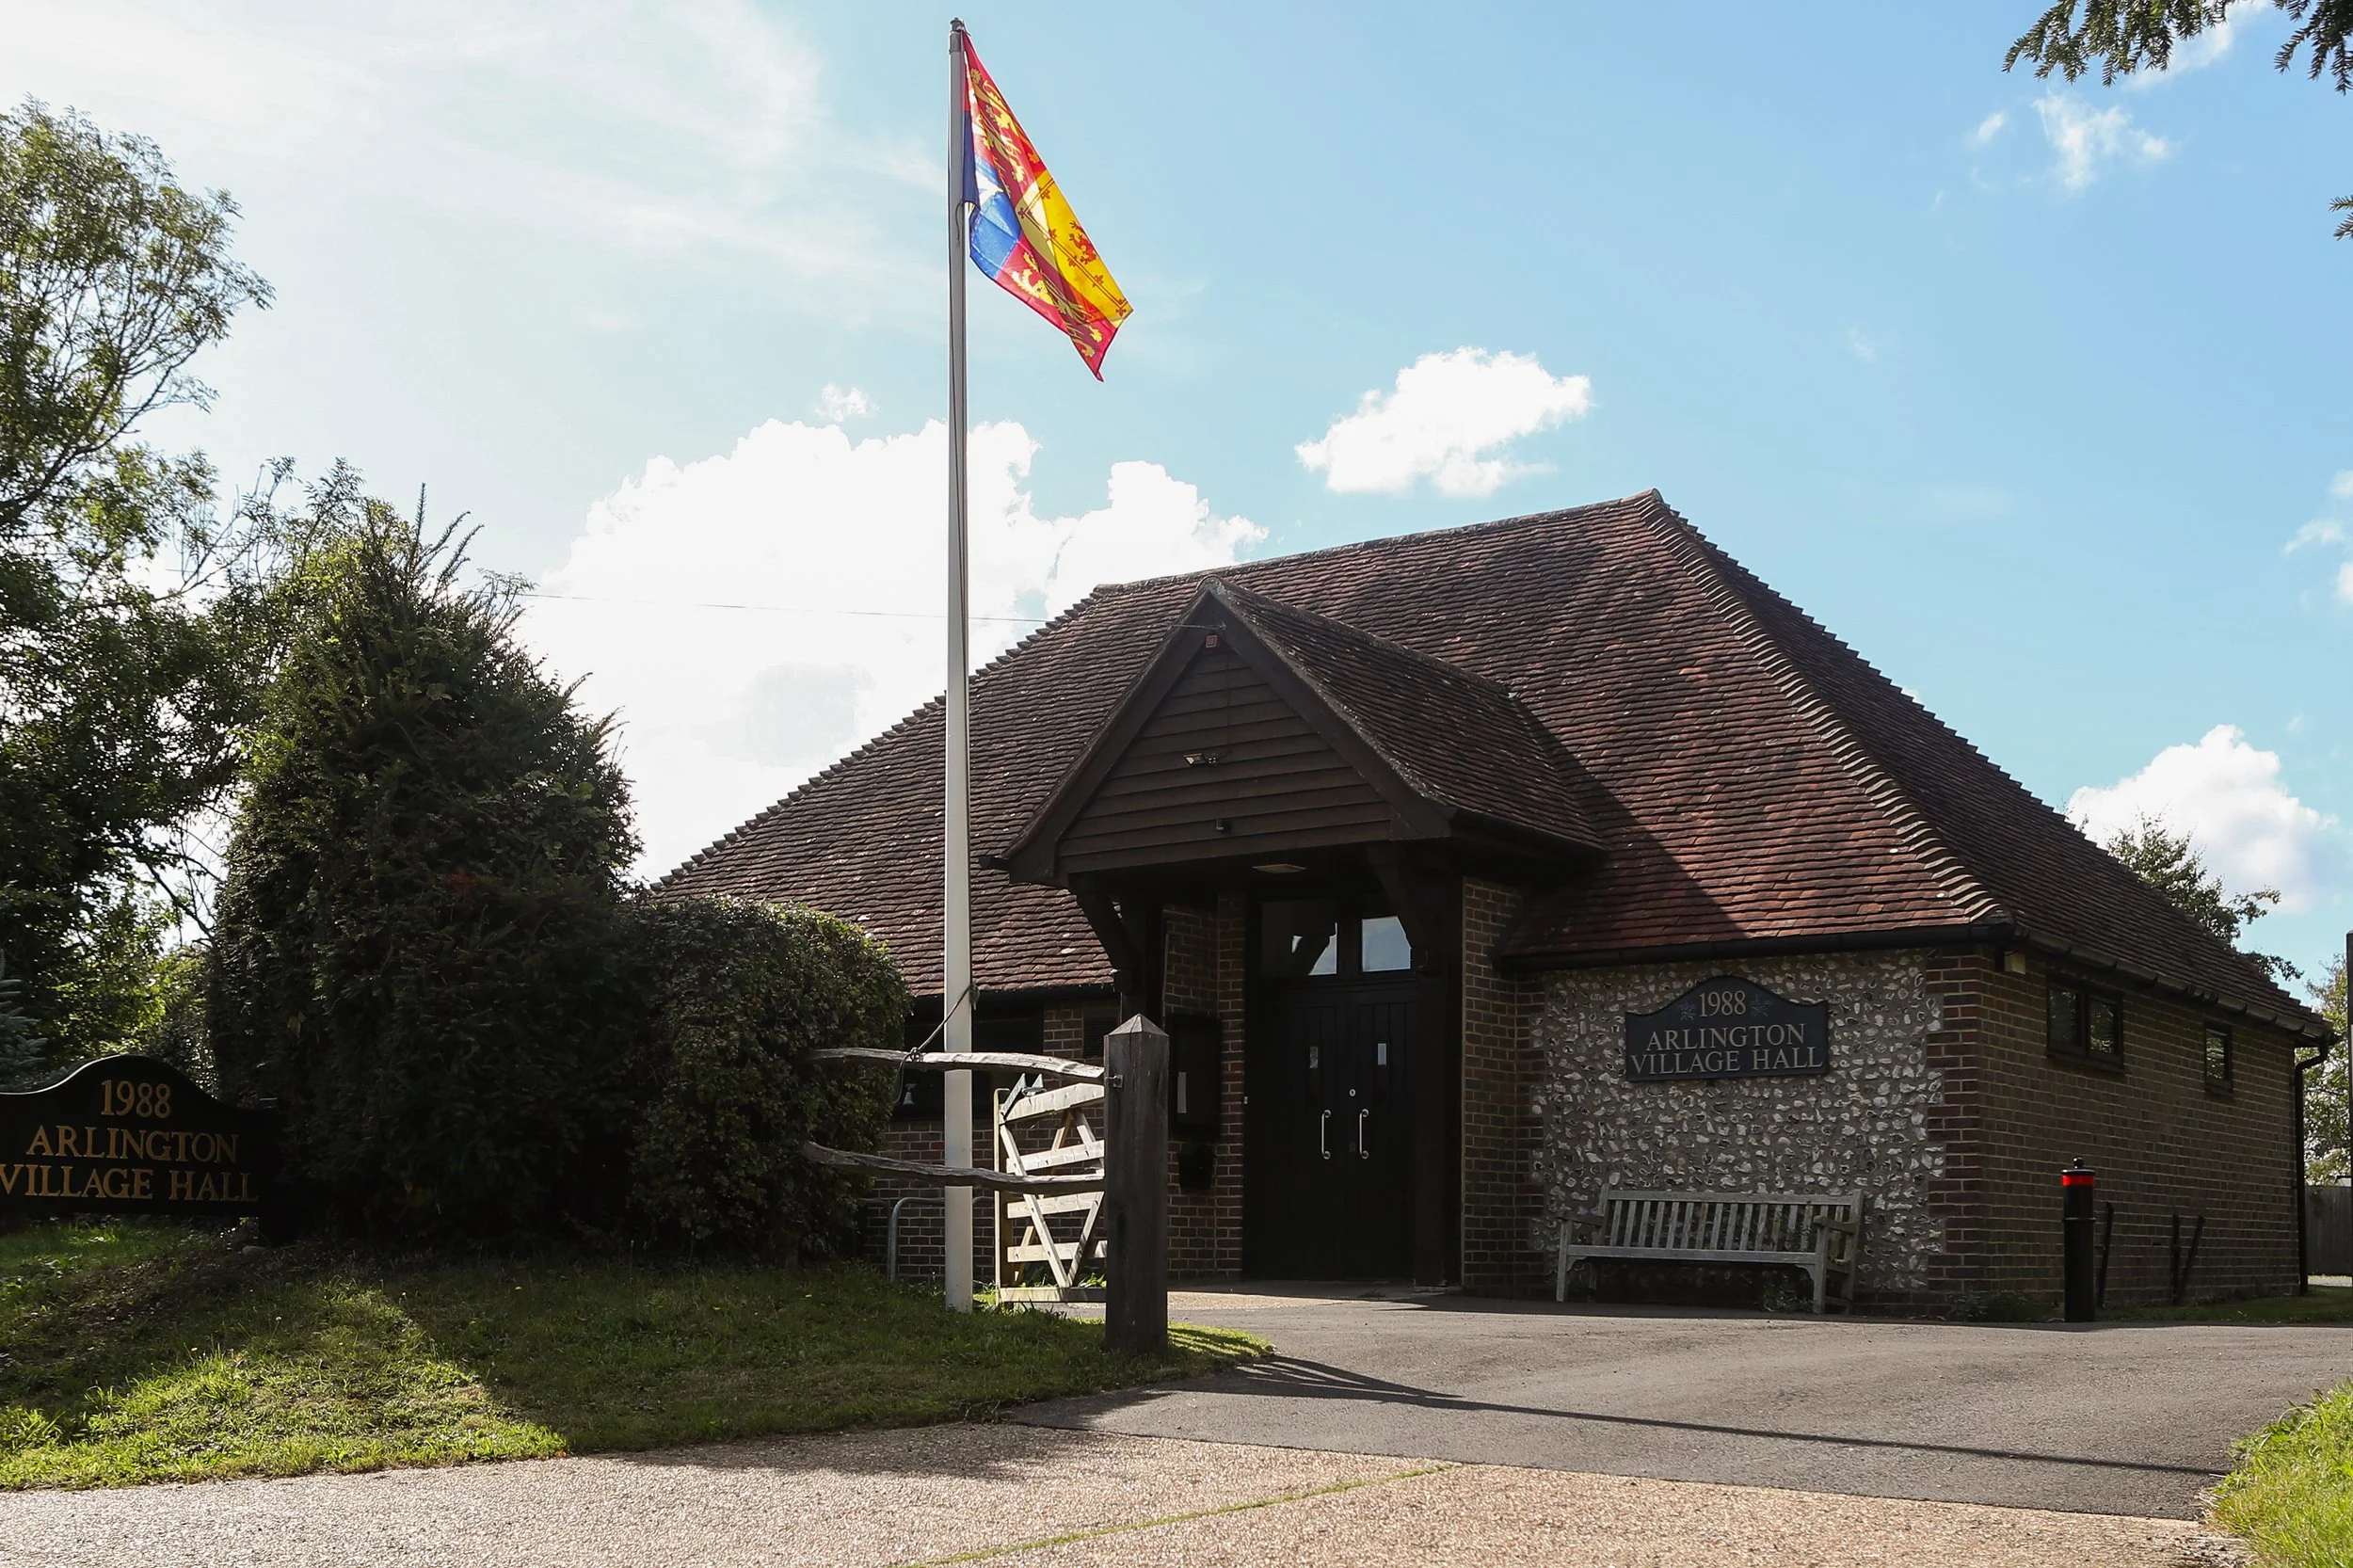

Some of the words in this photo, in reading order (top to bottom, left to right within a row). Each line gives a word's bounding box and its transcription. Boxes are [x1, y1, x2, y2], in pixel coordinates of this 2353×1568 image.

[1698, 990, 1747, 1017] 1988
[1645, 1023, 1806, 1051] ARLINGTON
[1630, 1051, 1741, 1075] VILLAGE
[1751, 1047, 1823, 1070] HALL
[100, 1079, 172, 1119] 1988
[25, 1125, 240, 1163] ARLINGTON
[0, 1163, 154, 1200] VILLAGE
[168, 1170, 260, 1202] HALL
